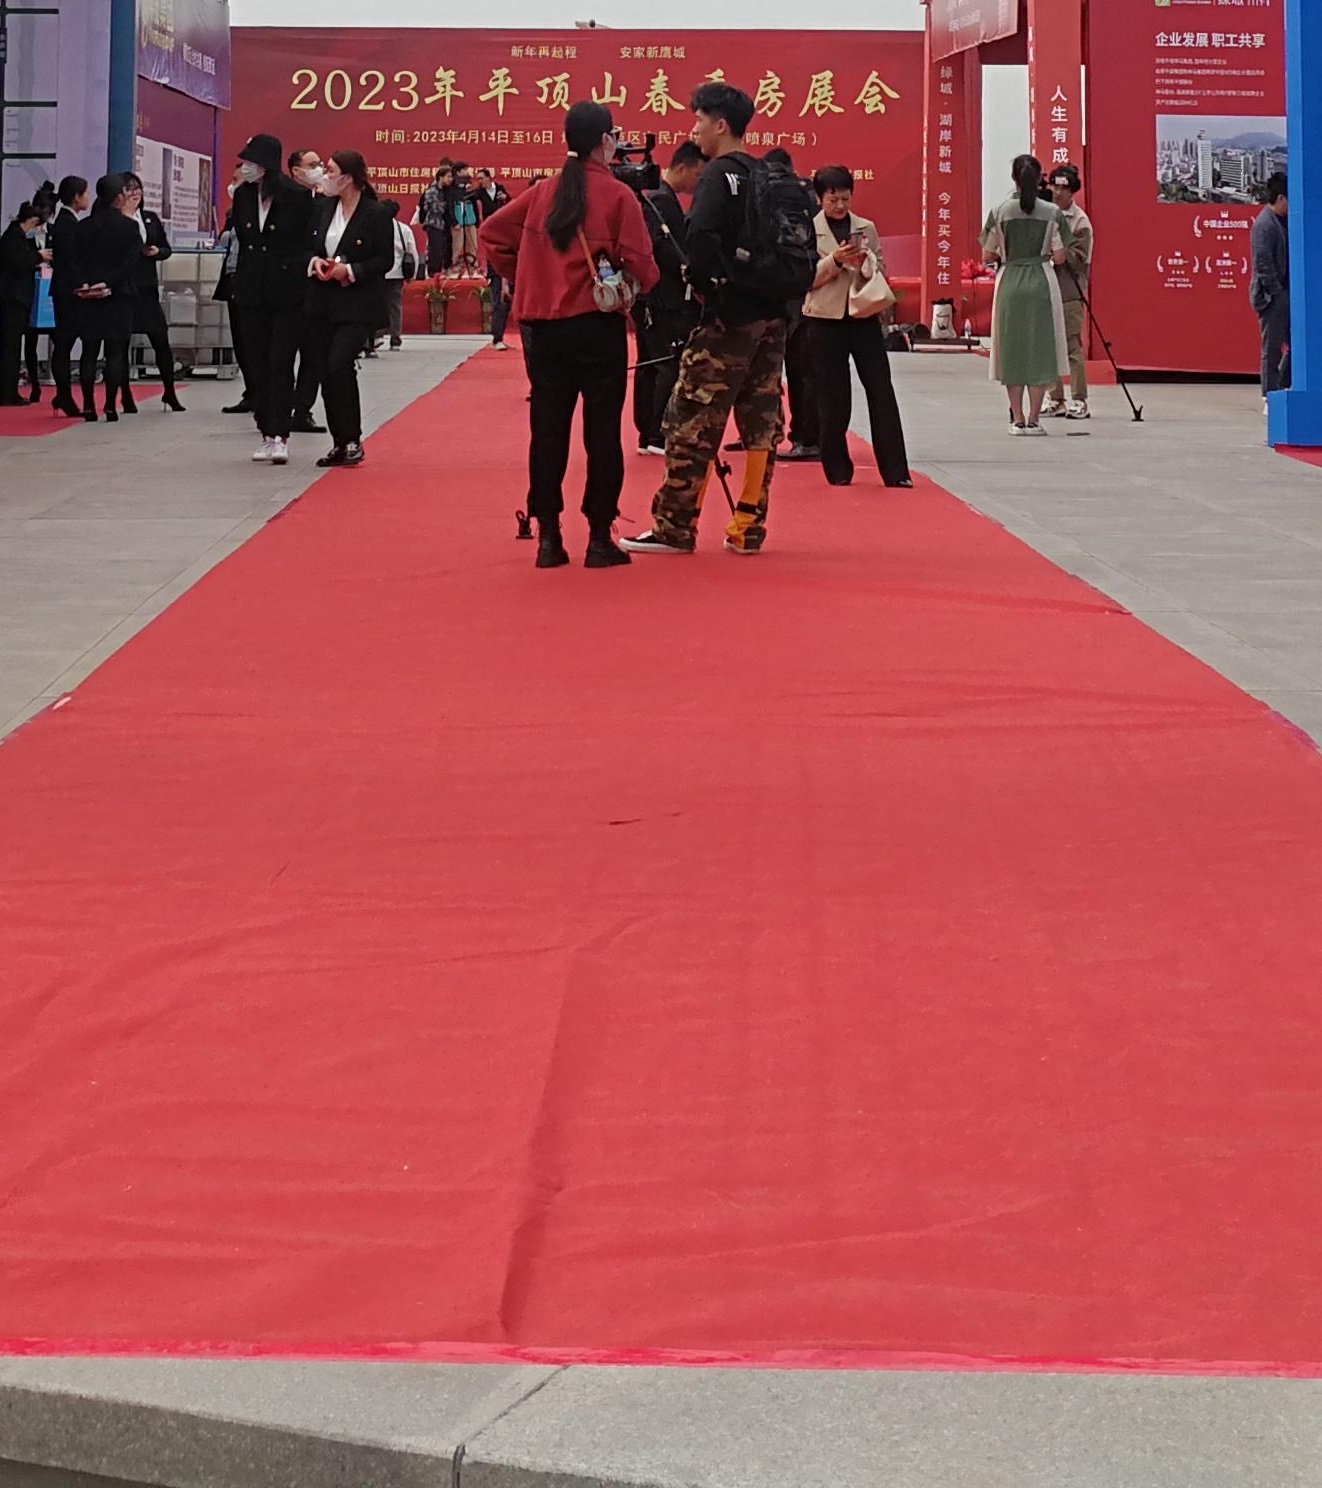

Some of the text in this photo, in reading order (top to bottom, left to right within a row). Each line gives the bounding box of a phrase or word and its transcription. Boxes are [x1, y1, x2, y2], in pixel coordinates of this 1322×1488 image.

[1155, 32, 1266, 48] 企业发展 职工共享
[510, 45, 686, 60] 新年再起程 安家新鹰城
